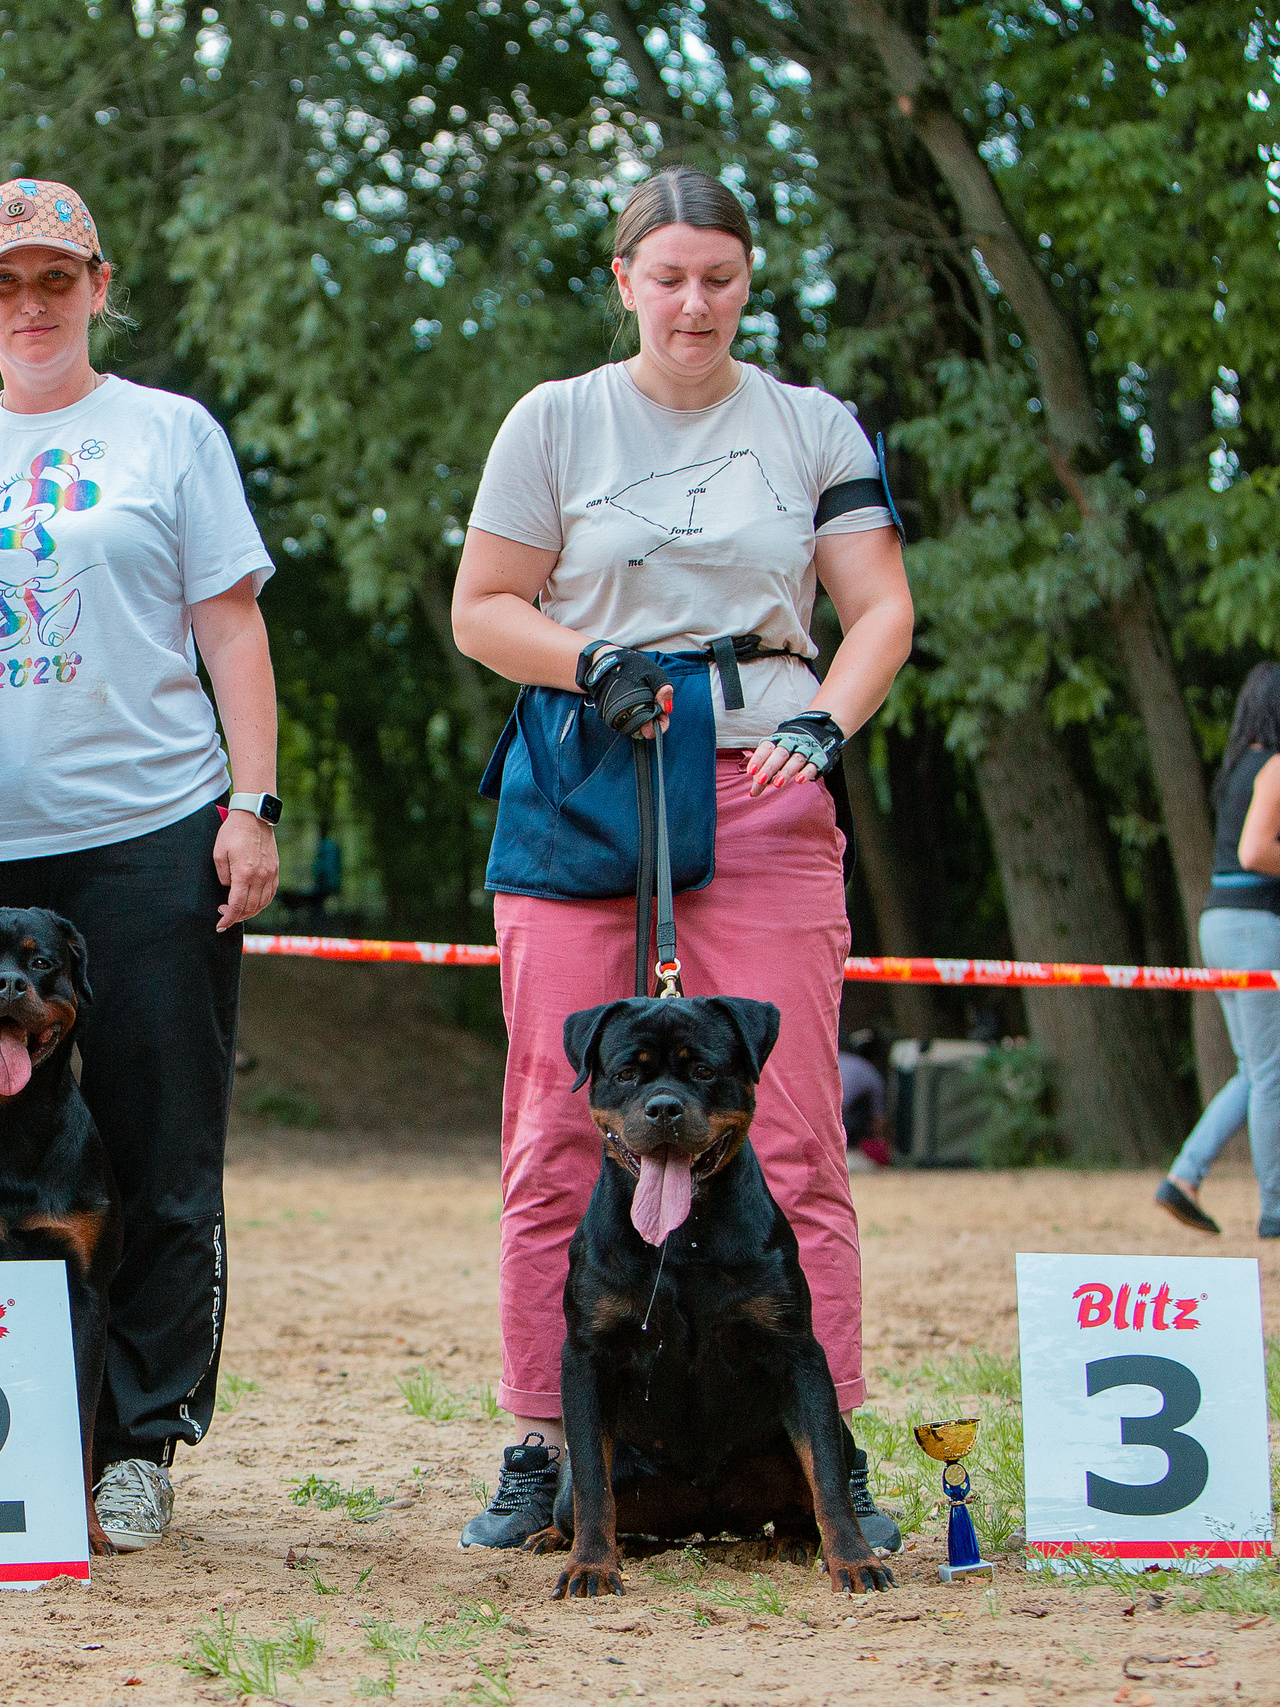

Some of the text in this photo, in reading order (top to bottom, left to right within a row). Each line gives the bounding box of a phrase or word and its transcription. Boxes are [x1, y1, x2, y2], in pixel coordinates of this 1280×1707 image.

[729, 448, 750, 459] love
[686, 486, 707, 497] you
[668, 526, 704, 536] forget
[628, 557, 644, 567] me
[1072, 1281, 1202, 1332] Blitz
[1085, 1354, 1210, 1517] 3
